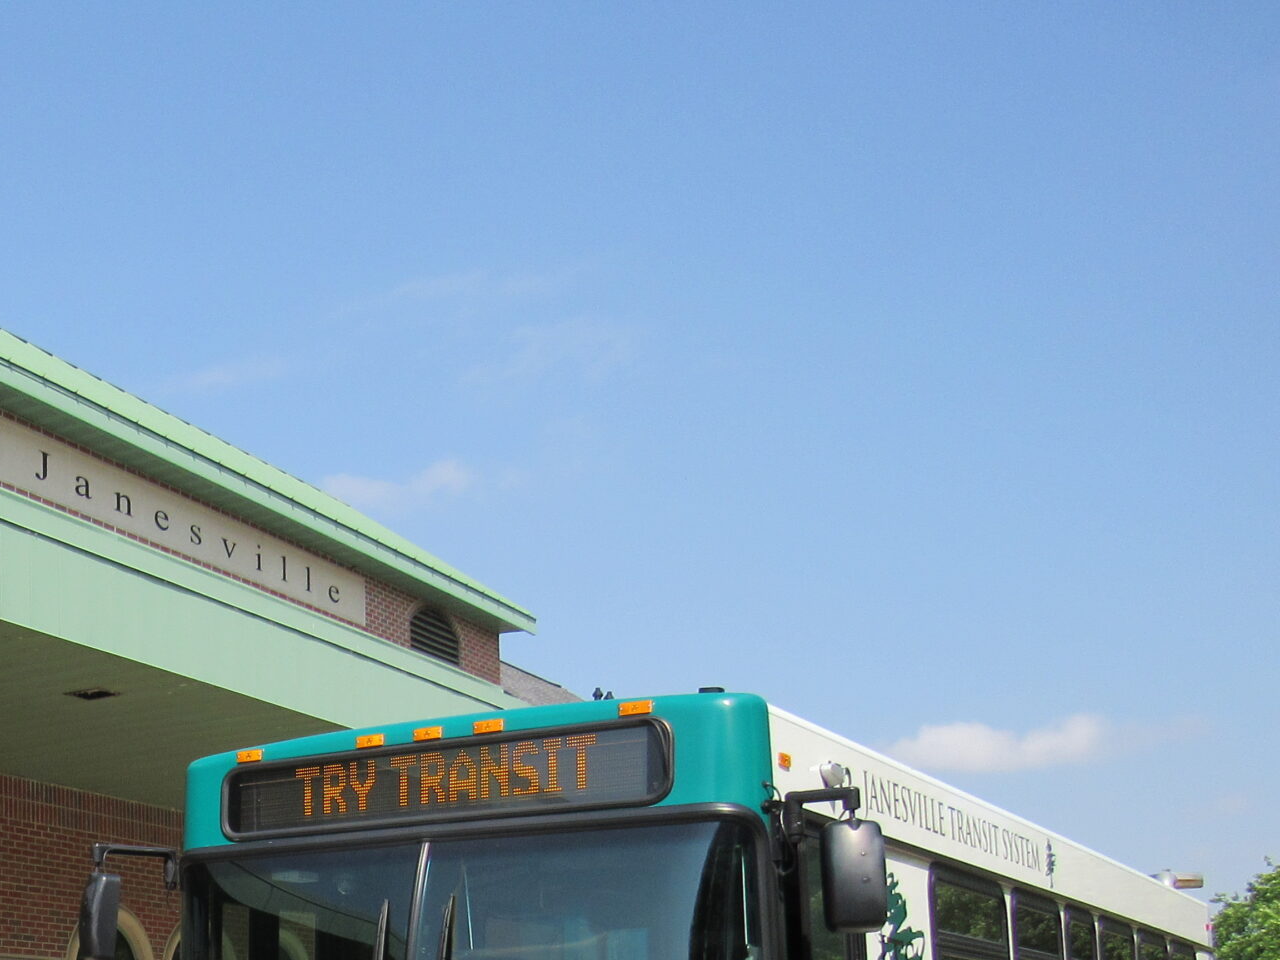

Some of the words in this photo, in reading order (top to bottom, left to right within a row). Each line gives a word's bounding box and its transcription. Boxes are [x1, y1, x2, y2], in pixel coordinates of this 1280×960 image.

[35, 450, 342, 604] Janesville
[295, 760, 376, 816] TRY
[390, 734, 596, 807] TRANSIT
[862, 770, 946, 837] JANESVILLE
[948, 806, 1001, 857] TRANSIT
[1002, 828, 1042, 872] SYSTEM
